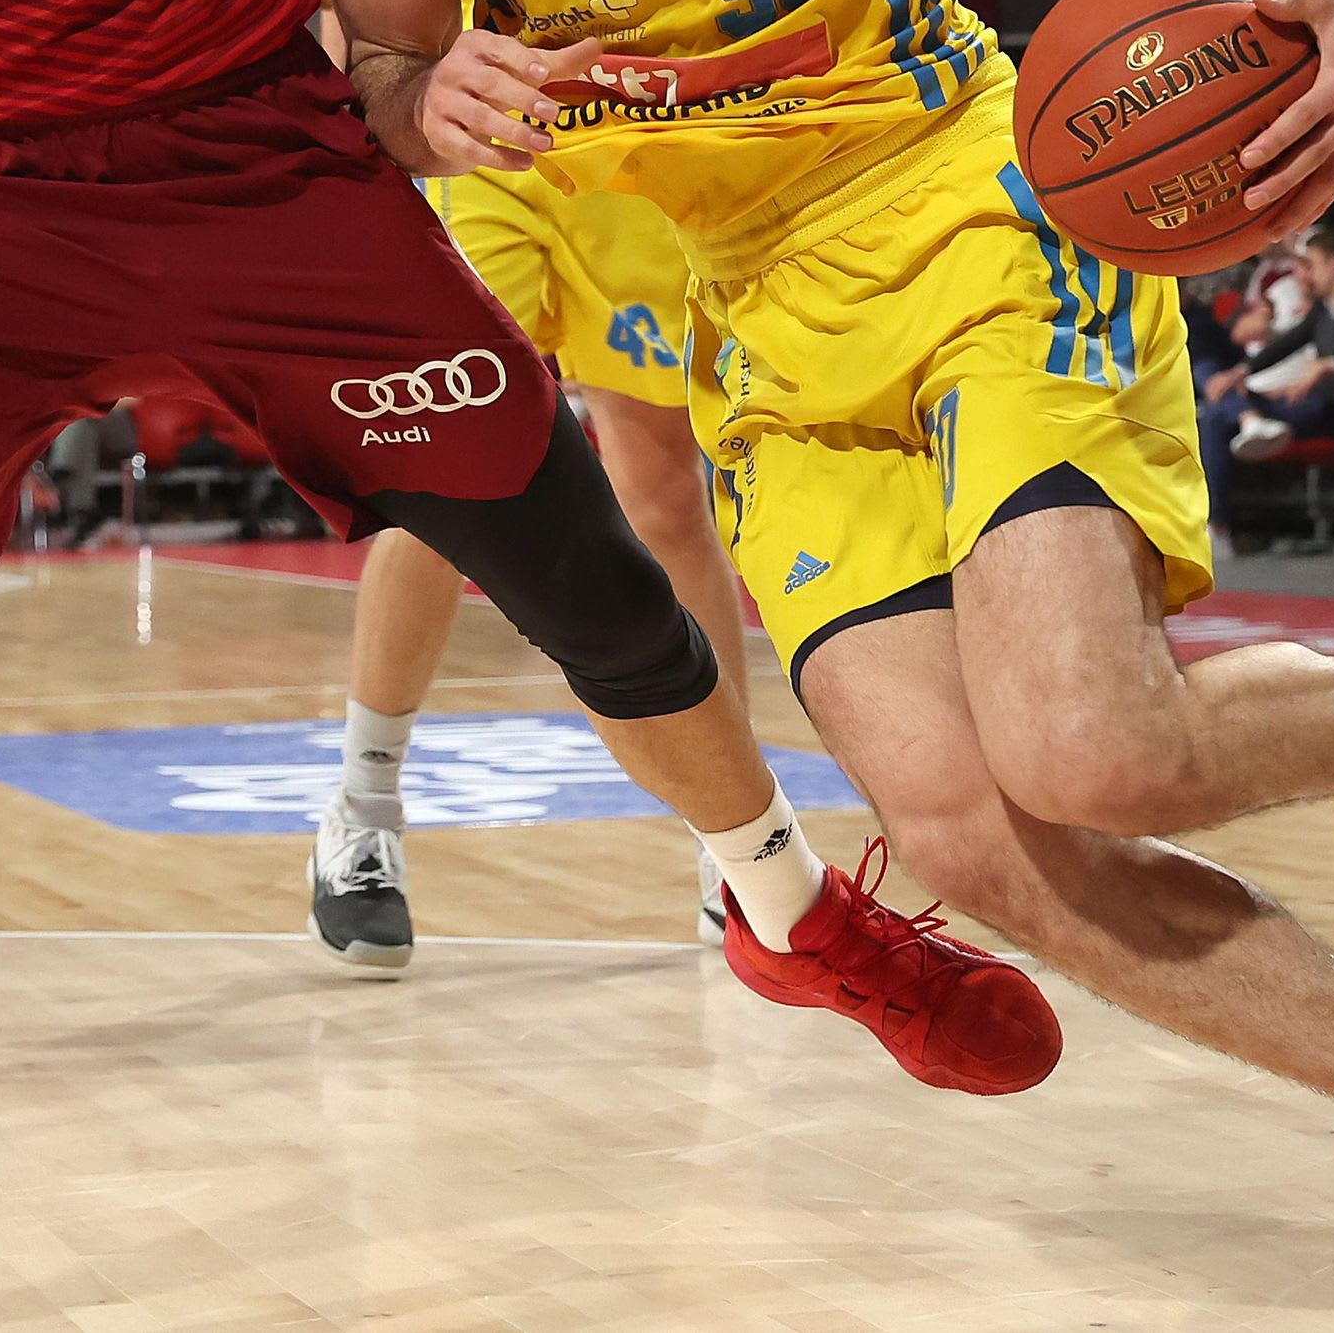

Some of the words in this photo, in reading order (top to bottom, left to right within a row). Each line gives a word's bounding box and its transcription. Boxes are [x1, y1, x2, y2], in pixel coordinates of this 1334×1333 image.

[1065, 22, 1271, 163] SPALDING
[361, 425, 431, 447] Audi
[784, 561, 830, 595] adidas
